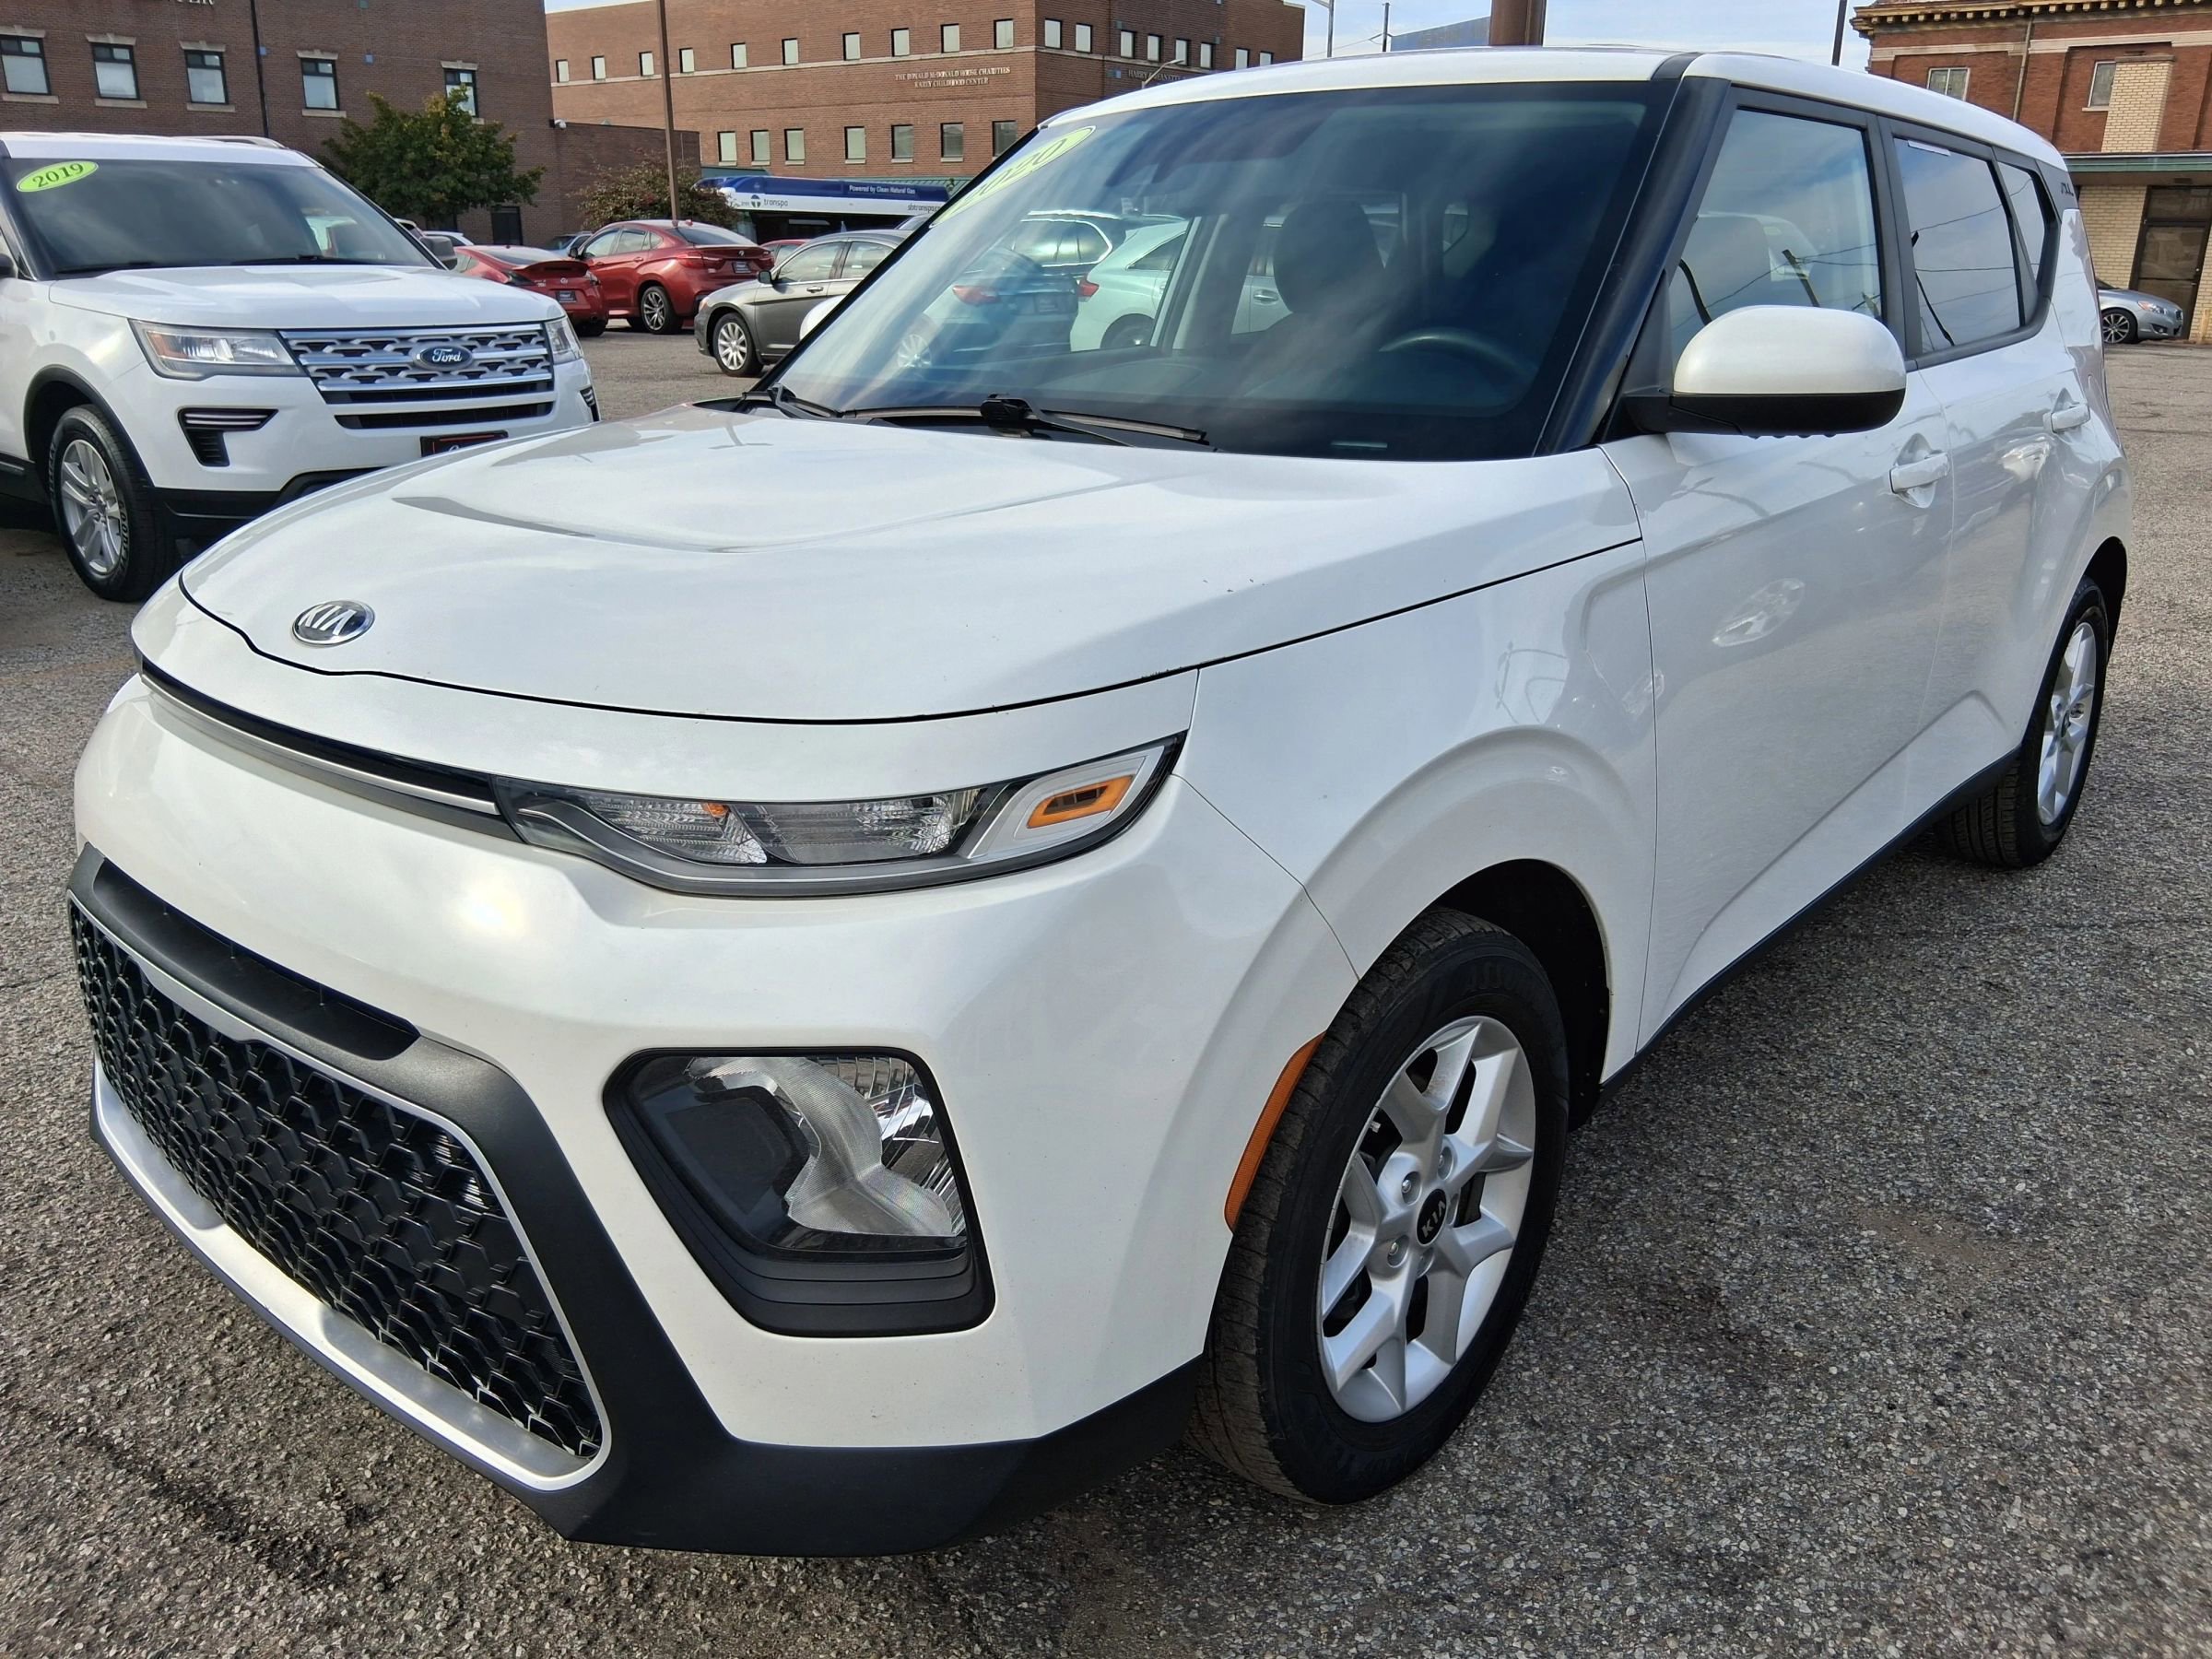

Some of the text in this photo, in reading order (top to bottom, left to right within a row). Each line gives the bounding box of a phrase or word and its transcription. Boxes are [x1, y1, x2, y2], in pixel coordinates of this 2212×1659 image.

[978, 67, 1011, 76] CHARITIES
[933, 78, 965, 87] CHILDHOOD
[32, 163, 84, 187] 2019
[431, 348, 462, 362] Ford
[297, 604, 358, 636] KIA
[1421, 1200, 1446, 1238] KIA
